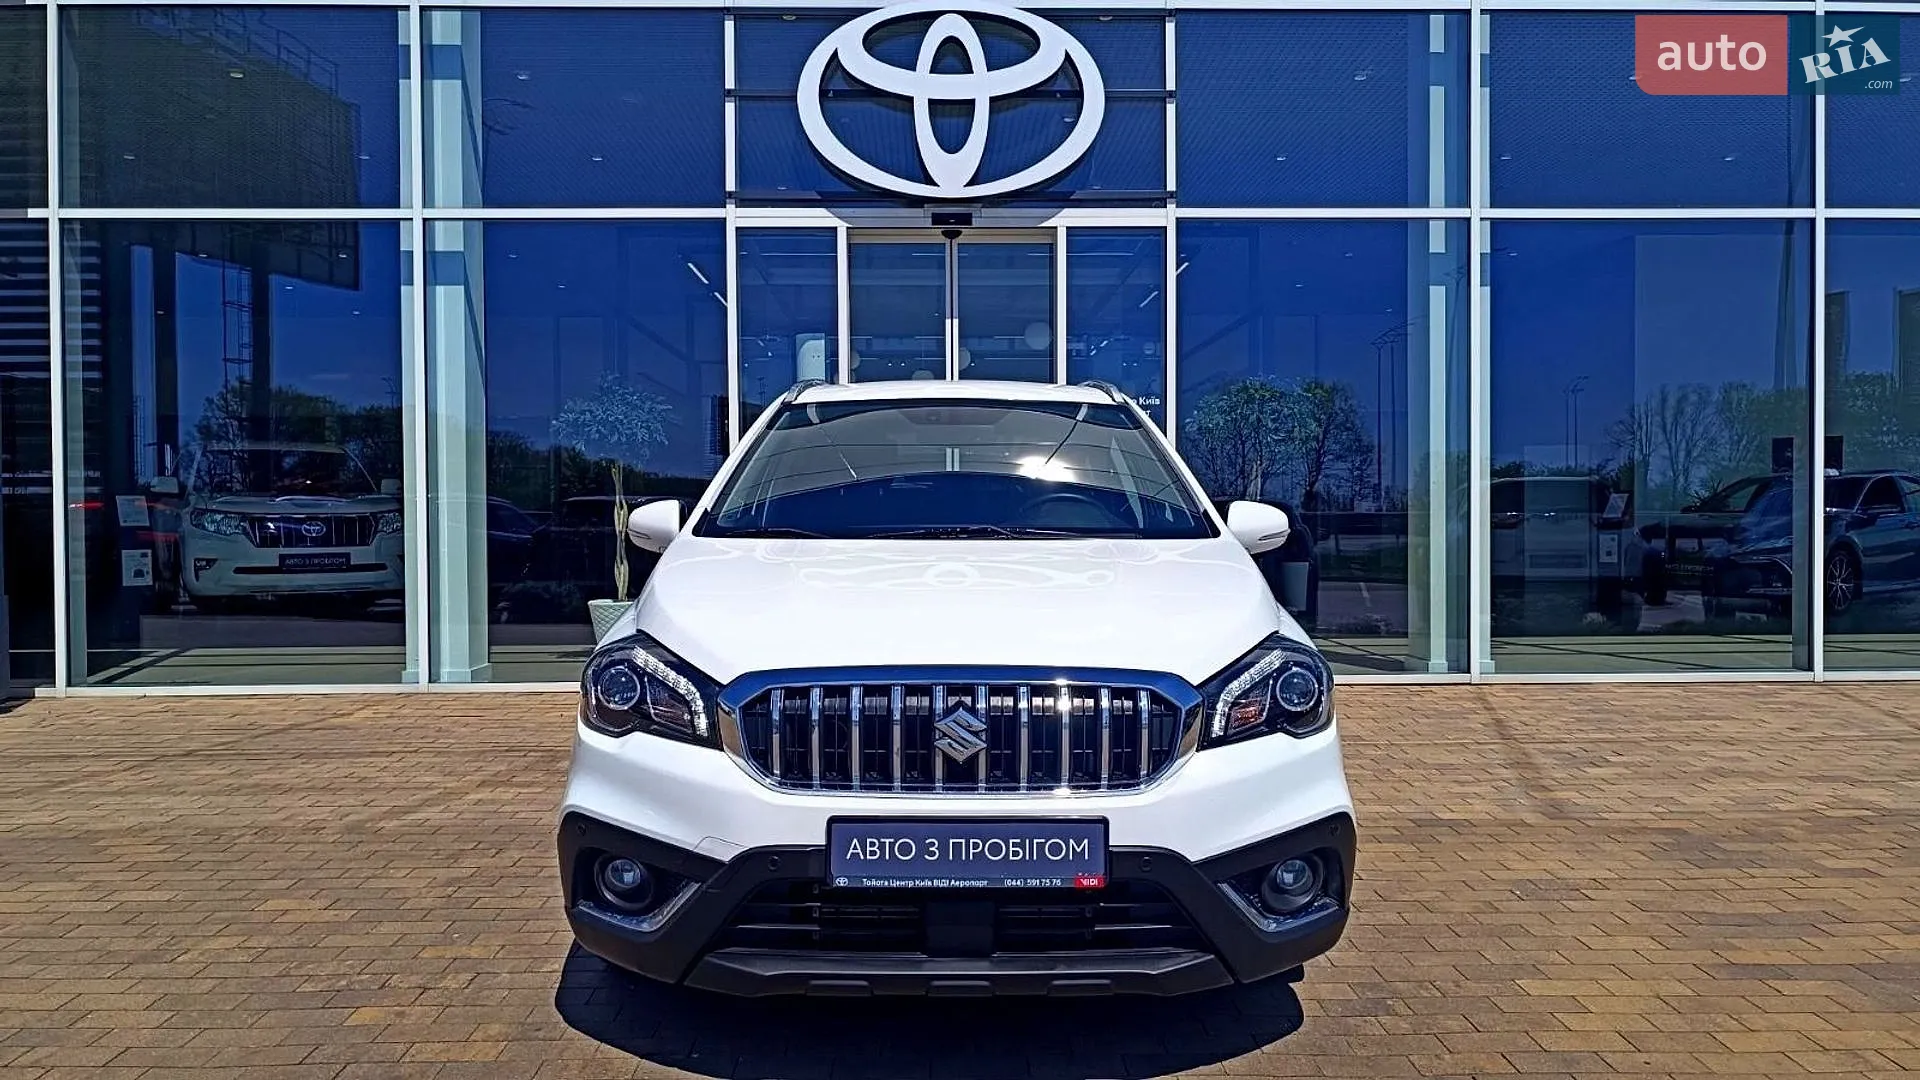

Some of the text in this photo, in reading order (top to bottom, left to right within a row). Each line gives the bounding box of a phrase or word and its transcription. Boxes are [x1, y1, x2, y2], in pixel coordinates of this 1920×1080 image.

[1138, 395, 1161, 405] Київ
[846, 838, 1089, 861] АВТО З ПРОБІГОМ
[862, 878, 888, 886] Тойота
[890, 878, 914, 888] Центр
[915, 877, 933, 887] Київ
[950, 878, 988, 888] Аеропорт
[1004, 878, 1024, 887] (044)
[1080, 878, 1098, 886] VIDI
